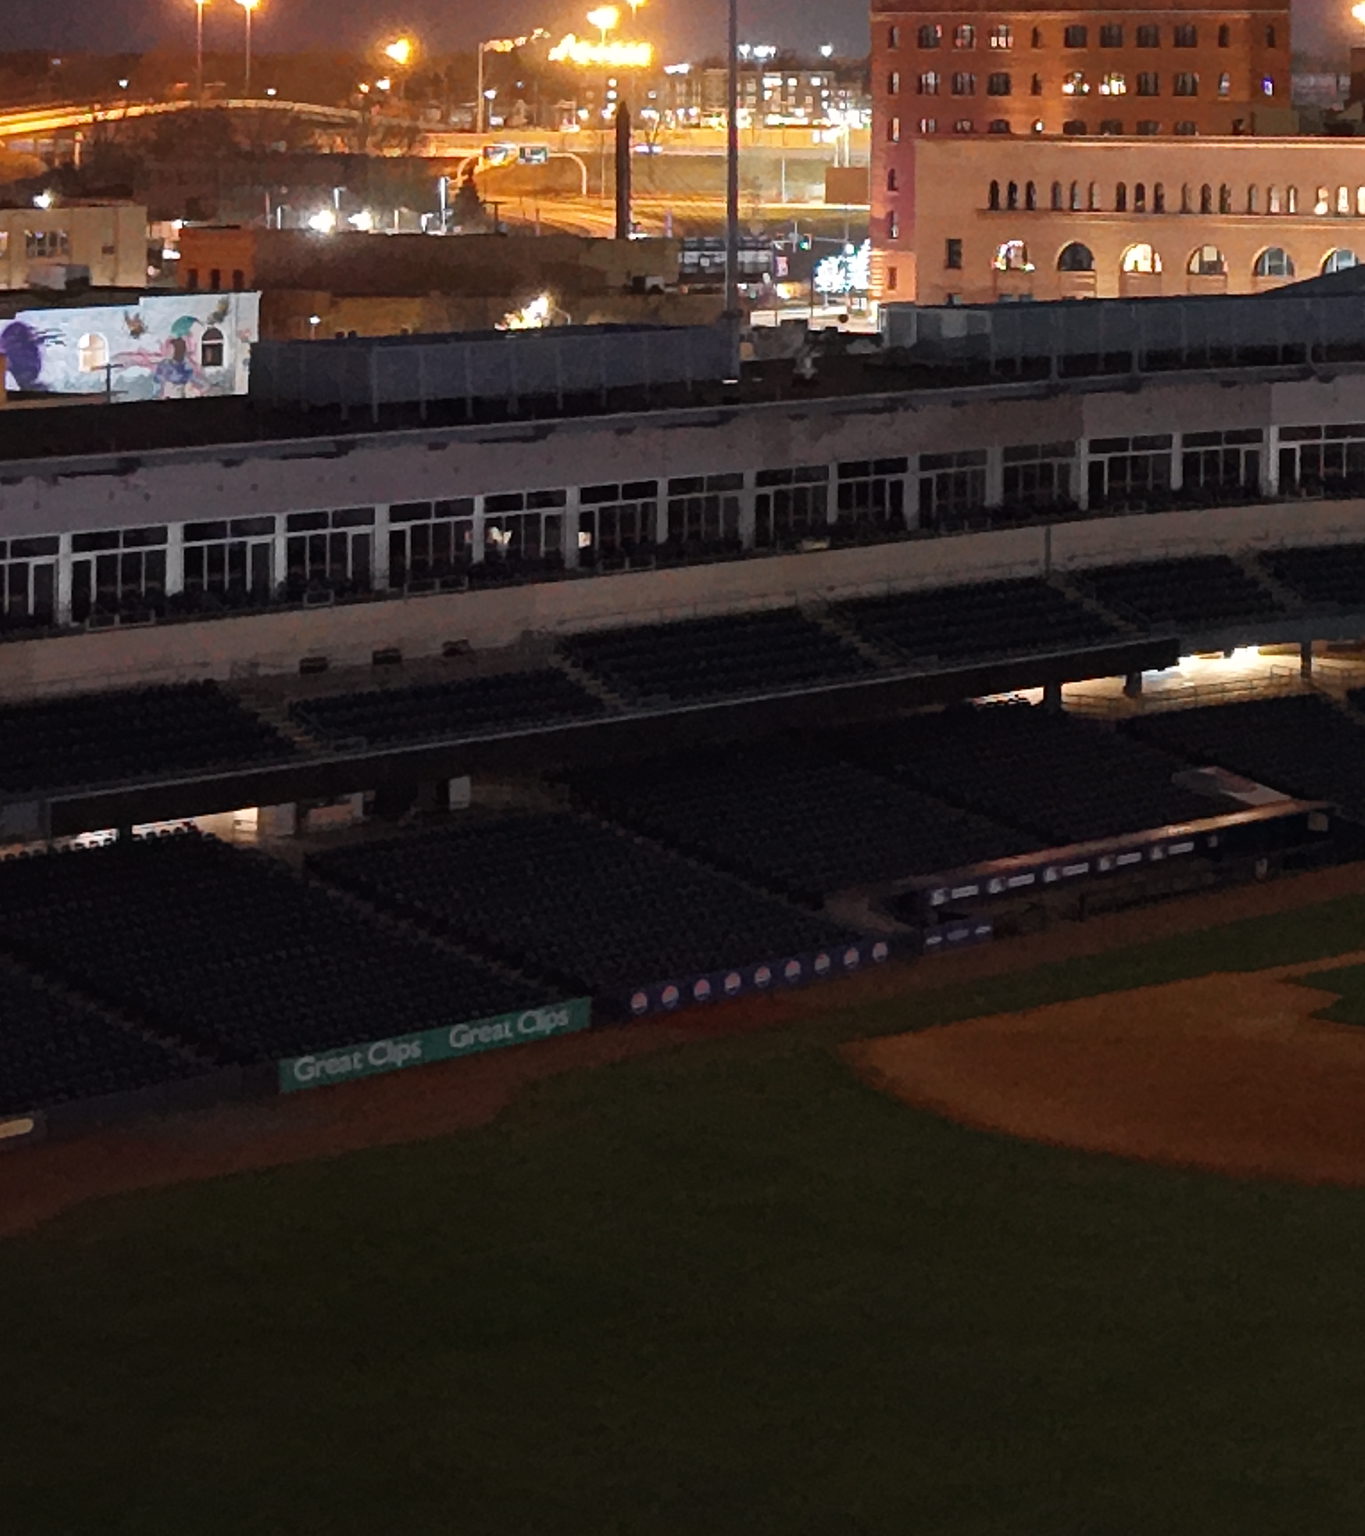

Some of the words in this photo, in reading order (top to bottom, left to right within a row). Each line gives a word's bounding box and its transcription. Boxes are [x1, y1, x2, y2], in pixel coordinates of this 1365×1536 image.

[293, 1055, 363, 1082] Great
[367, 1038, 422, 1067] Clips
[449, 1024, 513, 1048] Great
[517, 1008, 570, 1035] Clips
